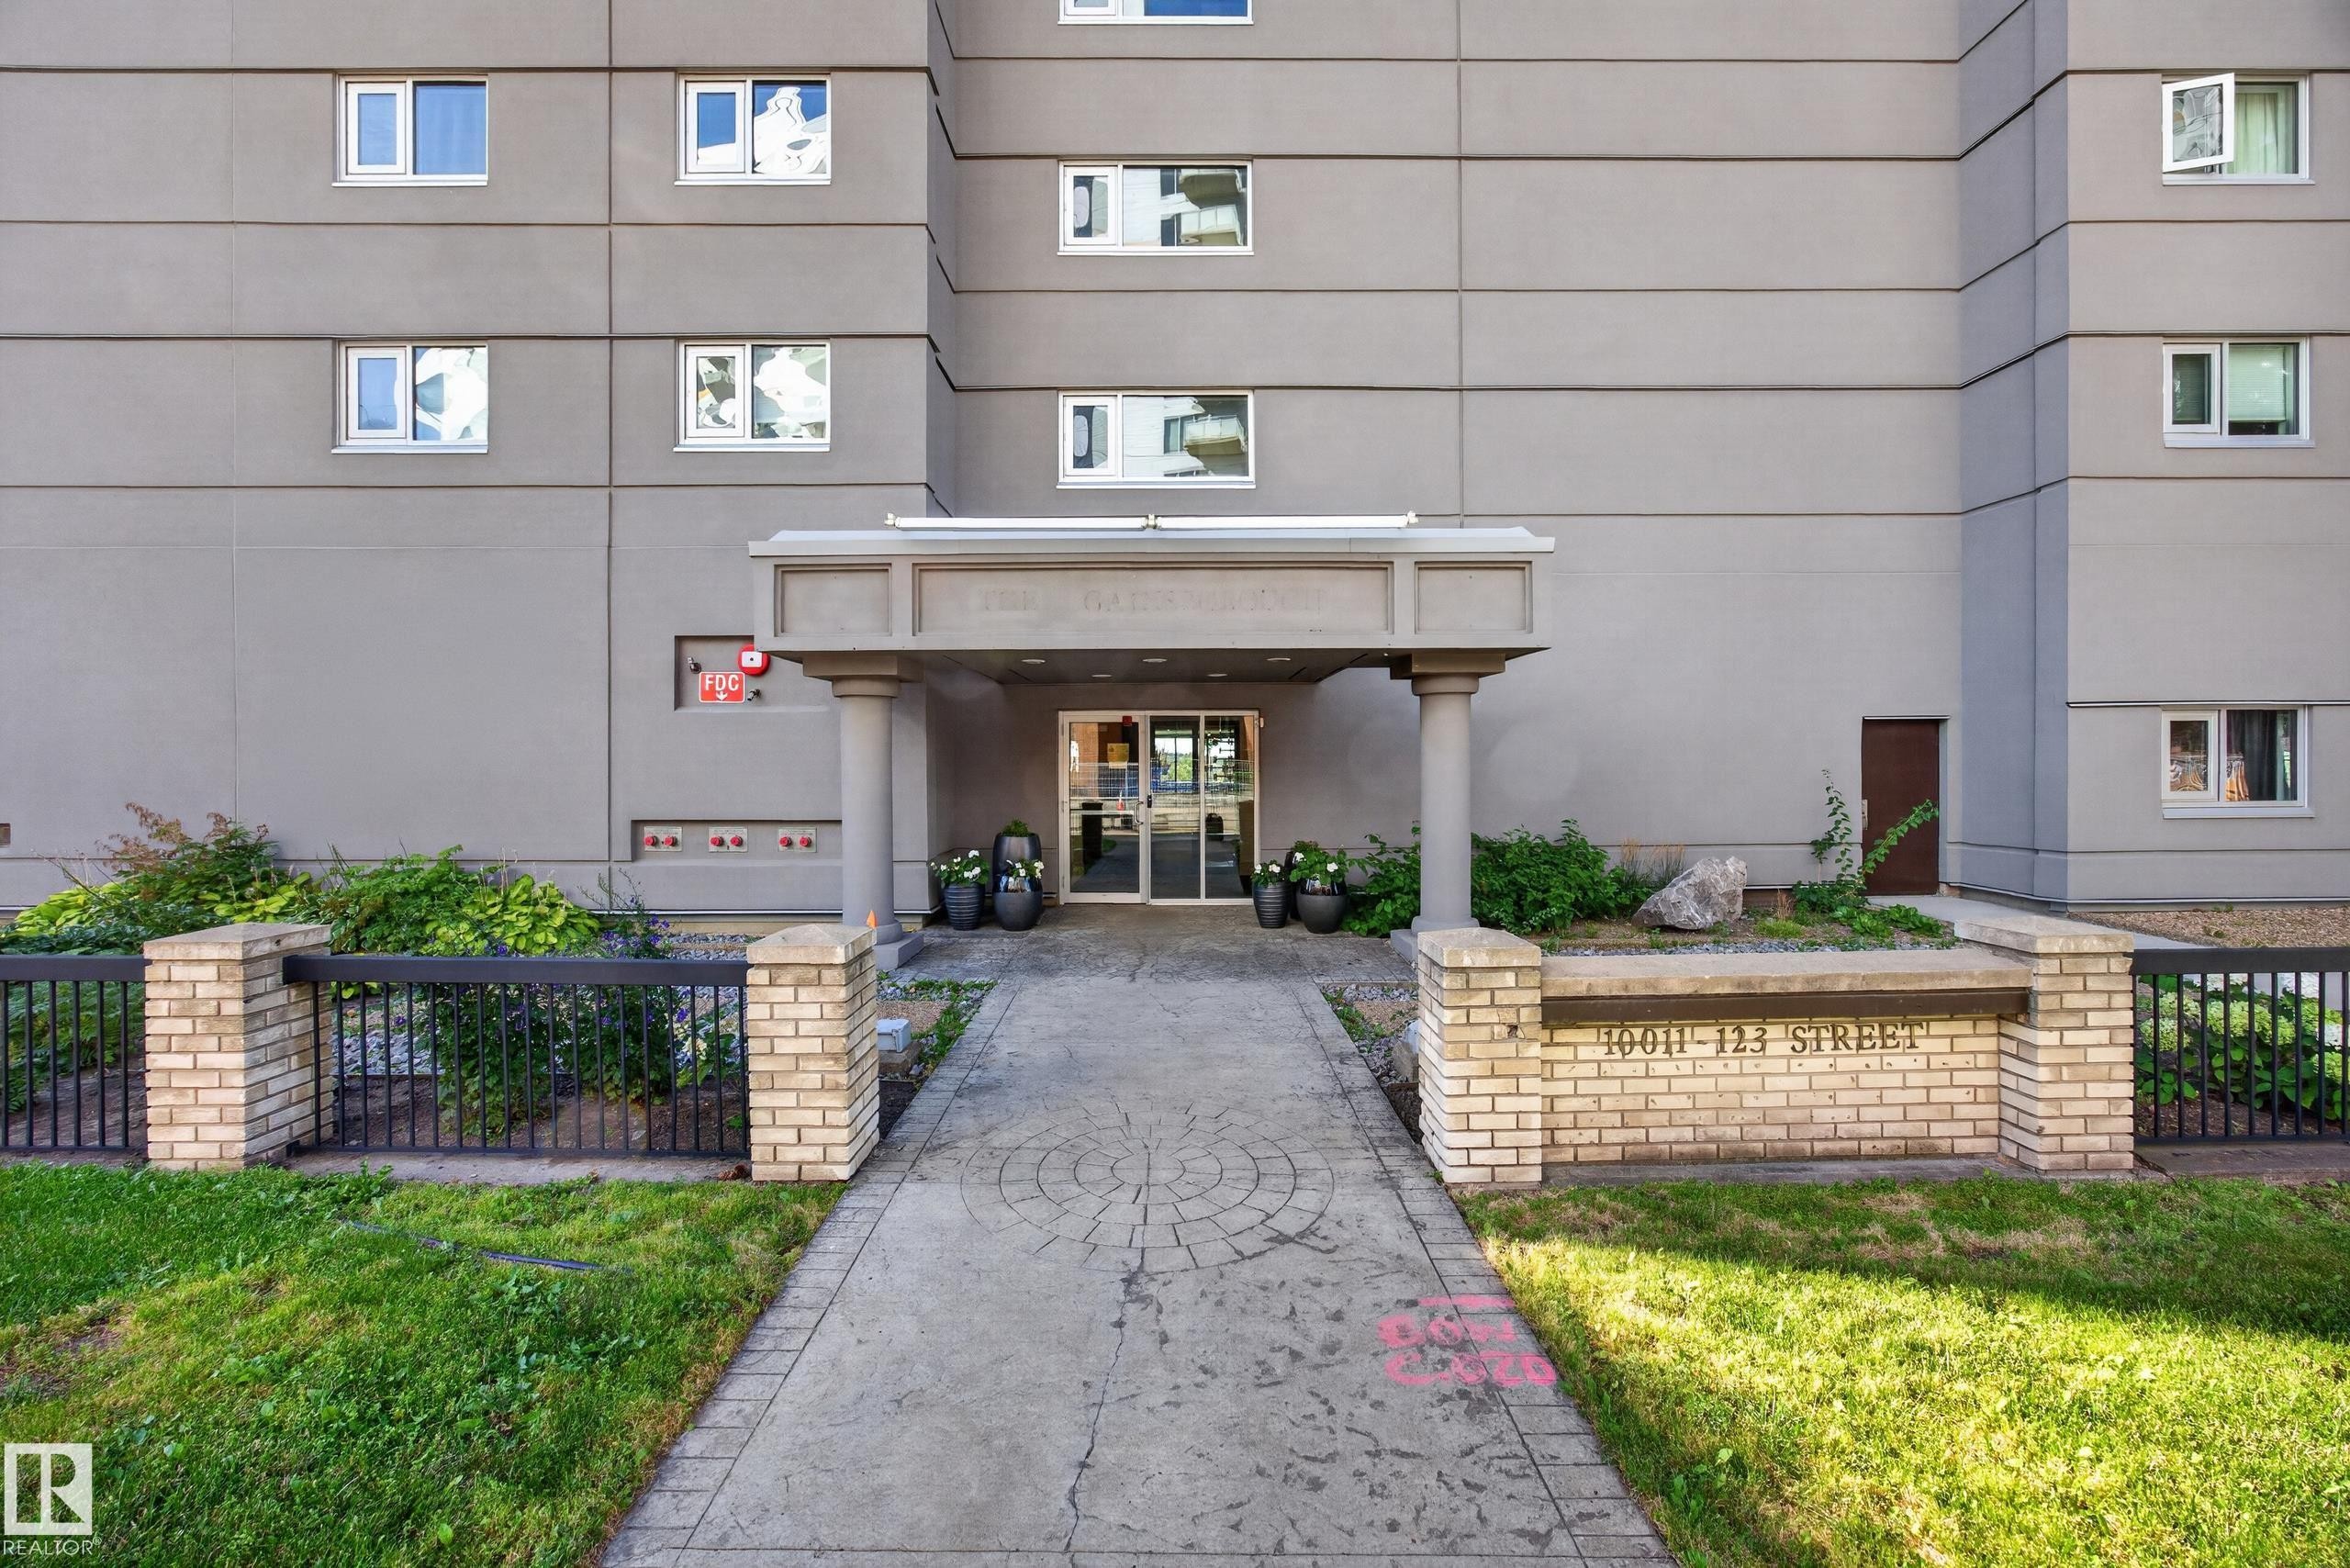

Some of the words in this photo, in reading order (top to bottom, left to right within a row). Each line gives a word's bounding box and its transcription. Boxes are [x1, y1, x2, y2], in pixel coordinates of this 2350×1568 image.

[704, 674, 740, 691] FDC
[1716, 1025, 1768, 1054] 123
[1790, 1022, 1924, 1054] STREET
